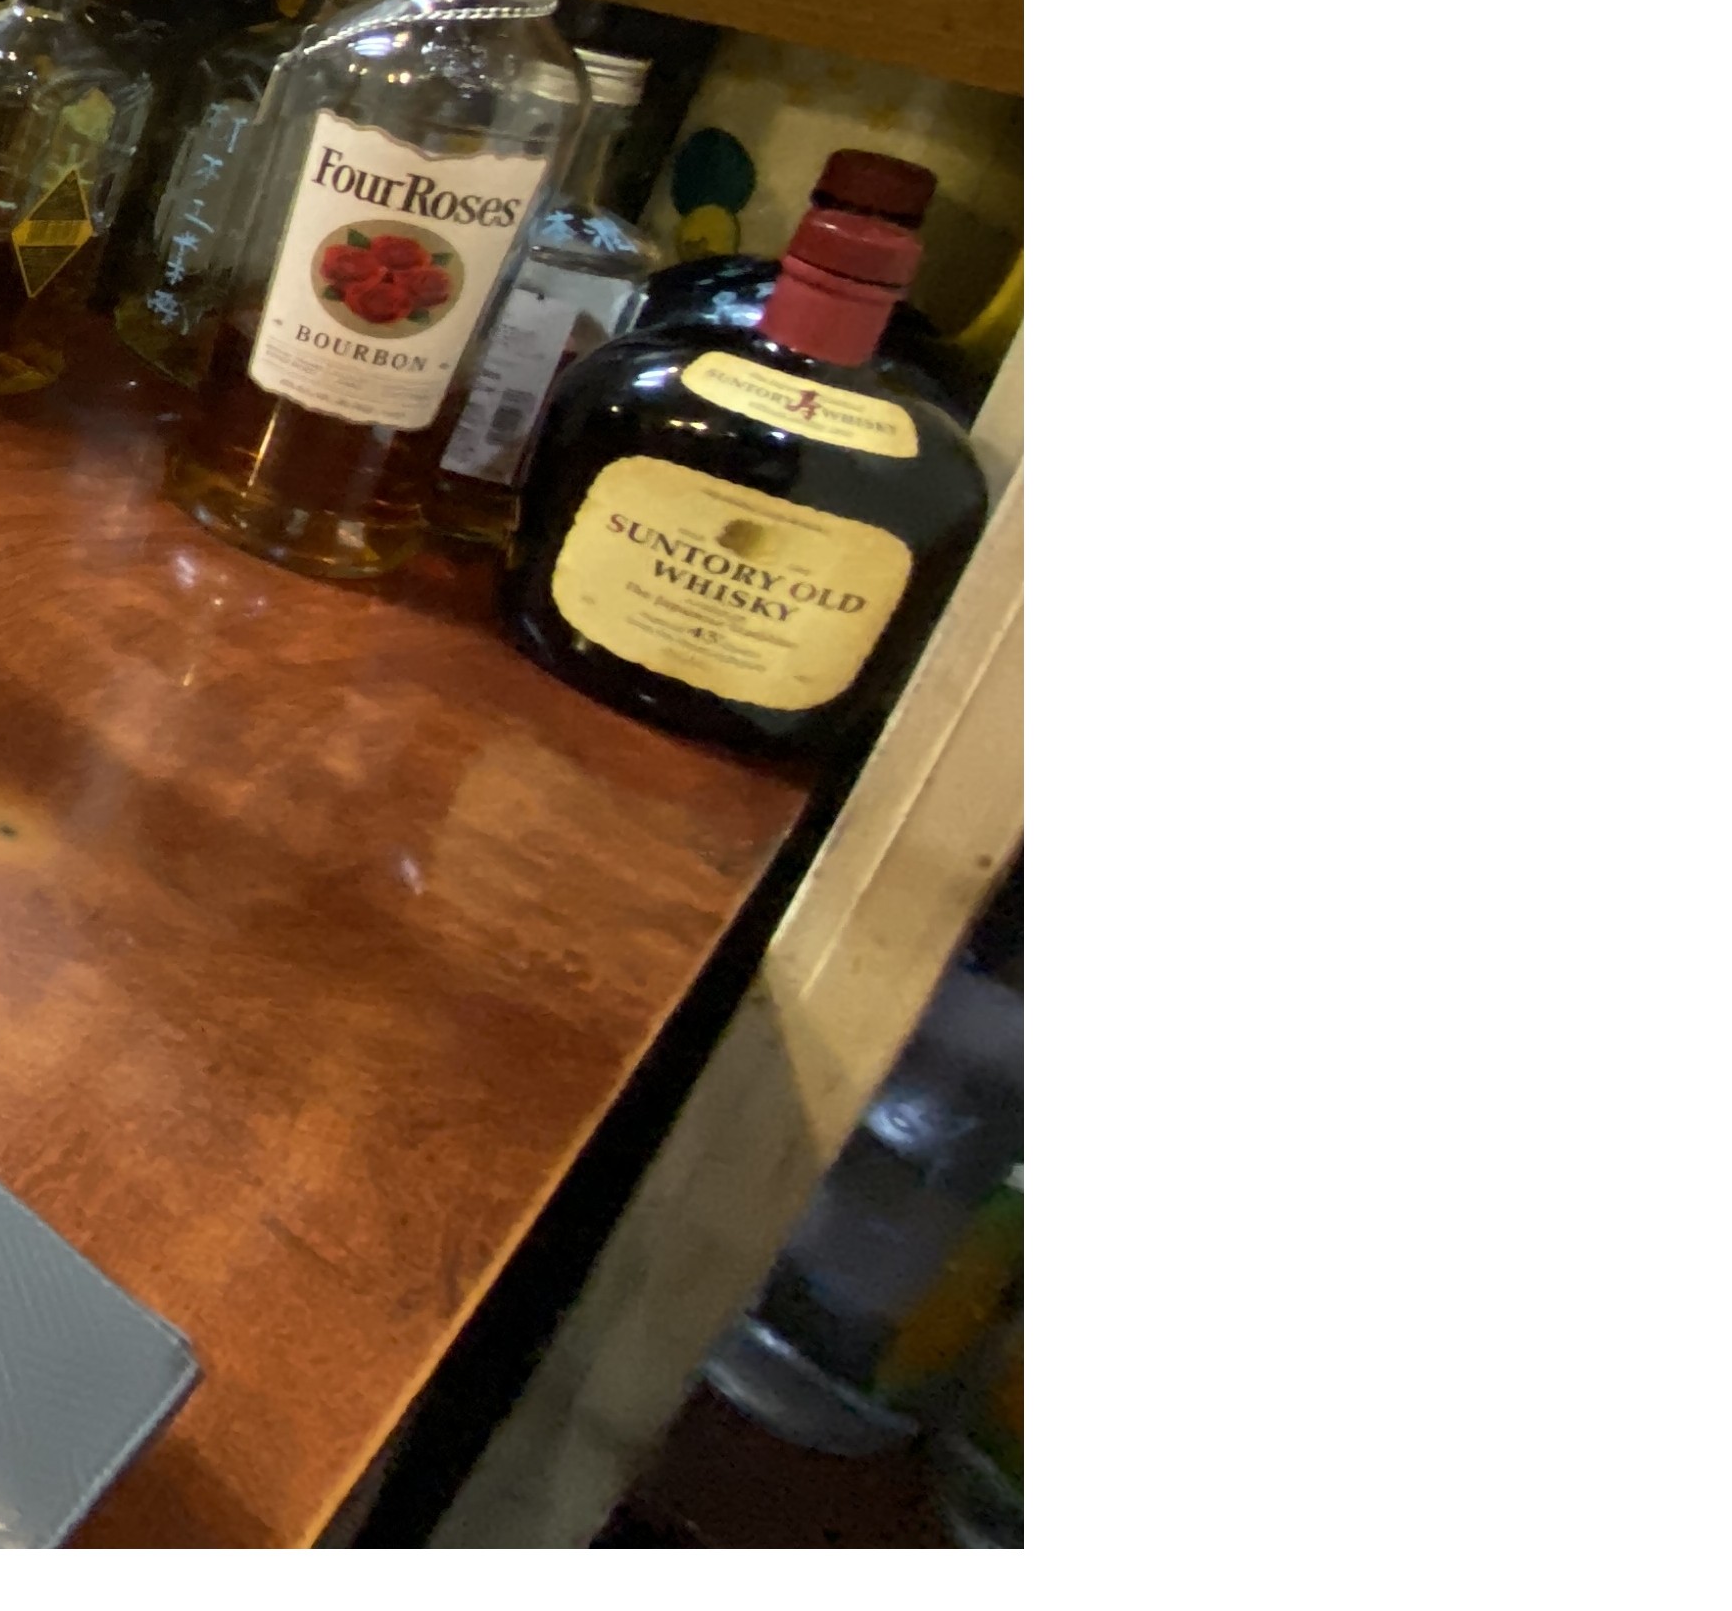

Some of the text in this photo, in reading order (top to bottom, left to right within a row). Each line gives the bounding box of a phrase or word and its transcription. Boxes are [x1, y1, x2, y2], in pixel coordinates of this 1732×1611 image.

[311, 145, 522, 228] Four Roses
[294, 322, 429, 373] BOURBON
[605, 512, 868, 615] SUNTORY OLD
[653, 558, 802, 623] WHISKY
